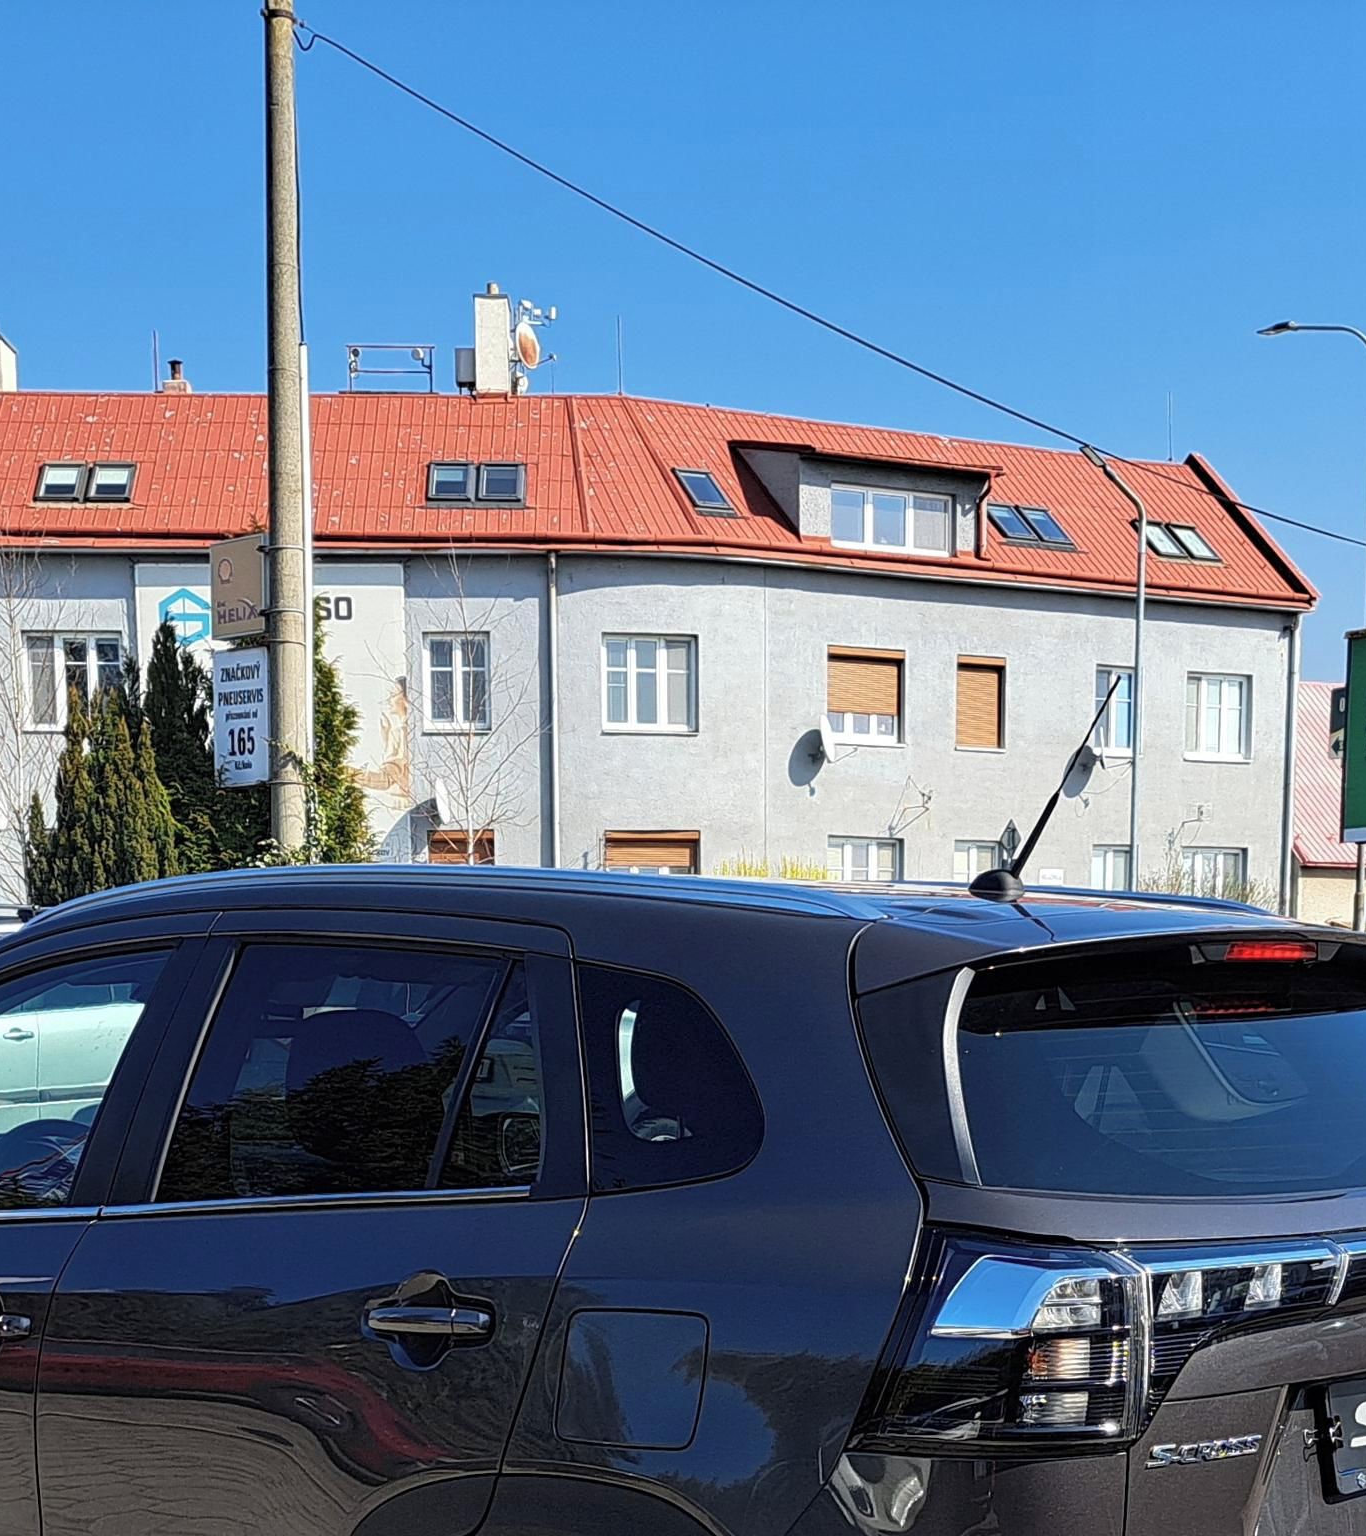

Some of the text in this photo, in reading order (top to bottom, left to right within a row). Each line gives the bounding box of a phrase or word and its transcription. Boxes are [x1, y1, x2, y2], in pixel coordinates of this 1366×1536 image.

[217, 602, 261, 625] HELIX
[220, 661, 261, 682] ZNAČKOVÝ
[218, 688, 264, 707] PNEUSERVIS
[228, 726, 255, 757] 165
